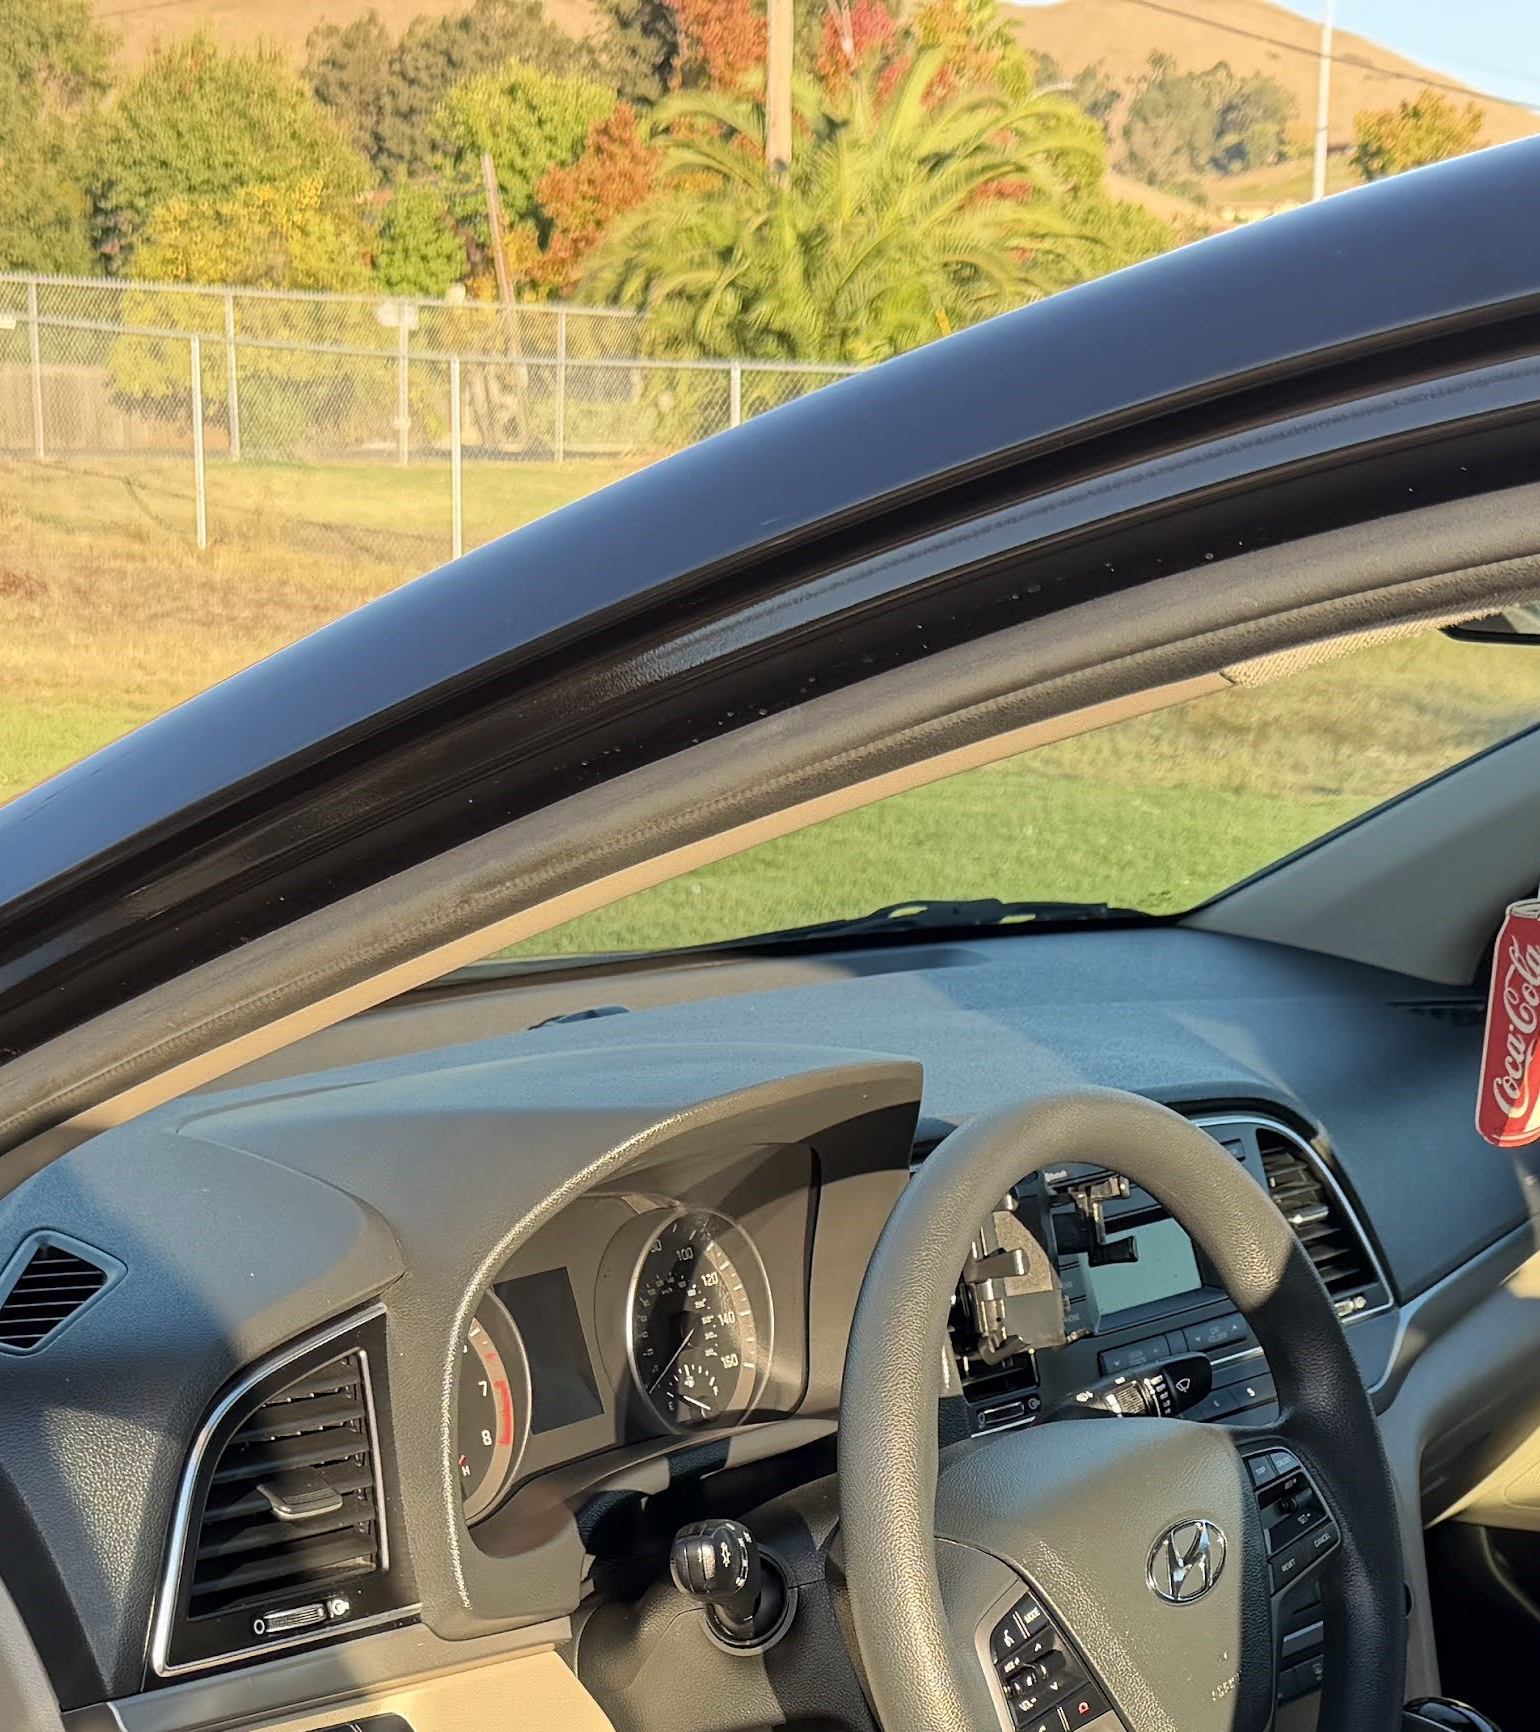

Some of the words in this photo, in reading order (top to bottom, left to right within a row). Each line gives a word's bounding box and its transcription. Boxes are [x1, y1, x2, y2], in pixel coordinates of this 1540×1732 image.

[676, 1247, 694, 1261] 100
[701, 1272, 719, 1287] 120
[717, 1311, 736, 1327] 140
[721, 1353, 739, 1369] 160
[478, 1380, 488, 1397] 7
[481, 1429, 493, 1446] 8
[461, 1465, 471, 1477] H
